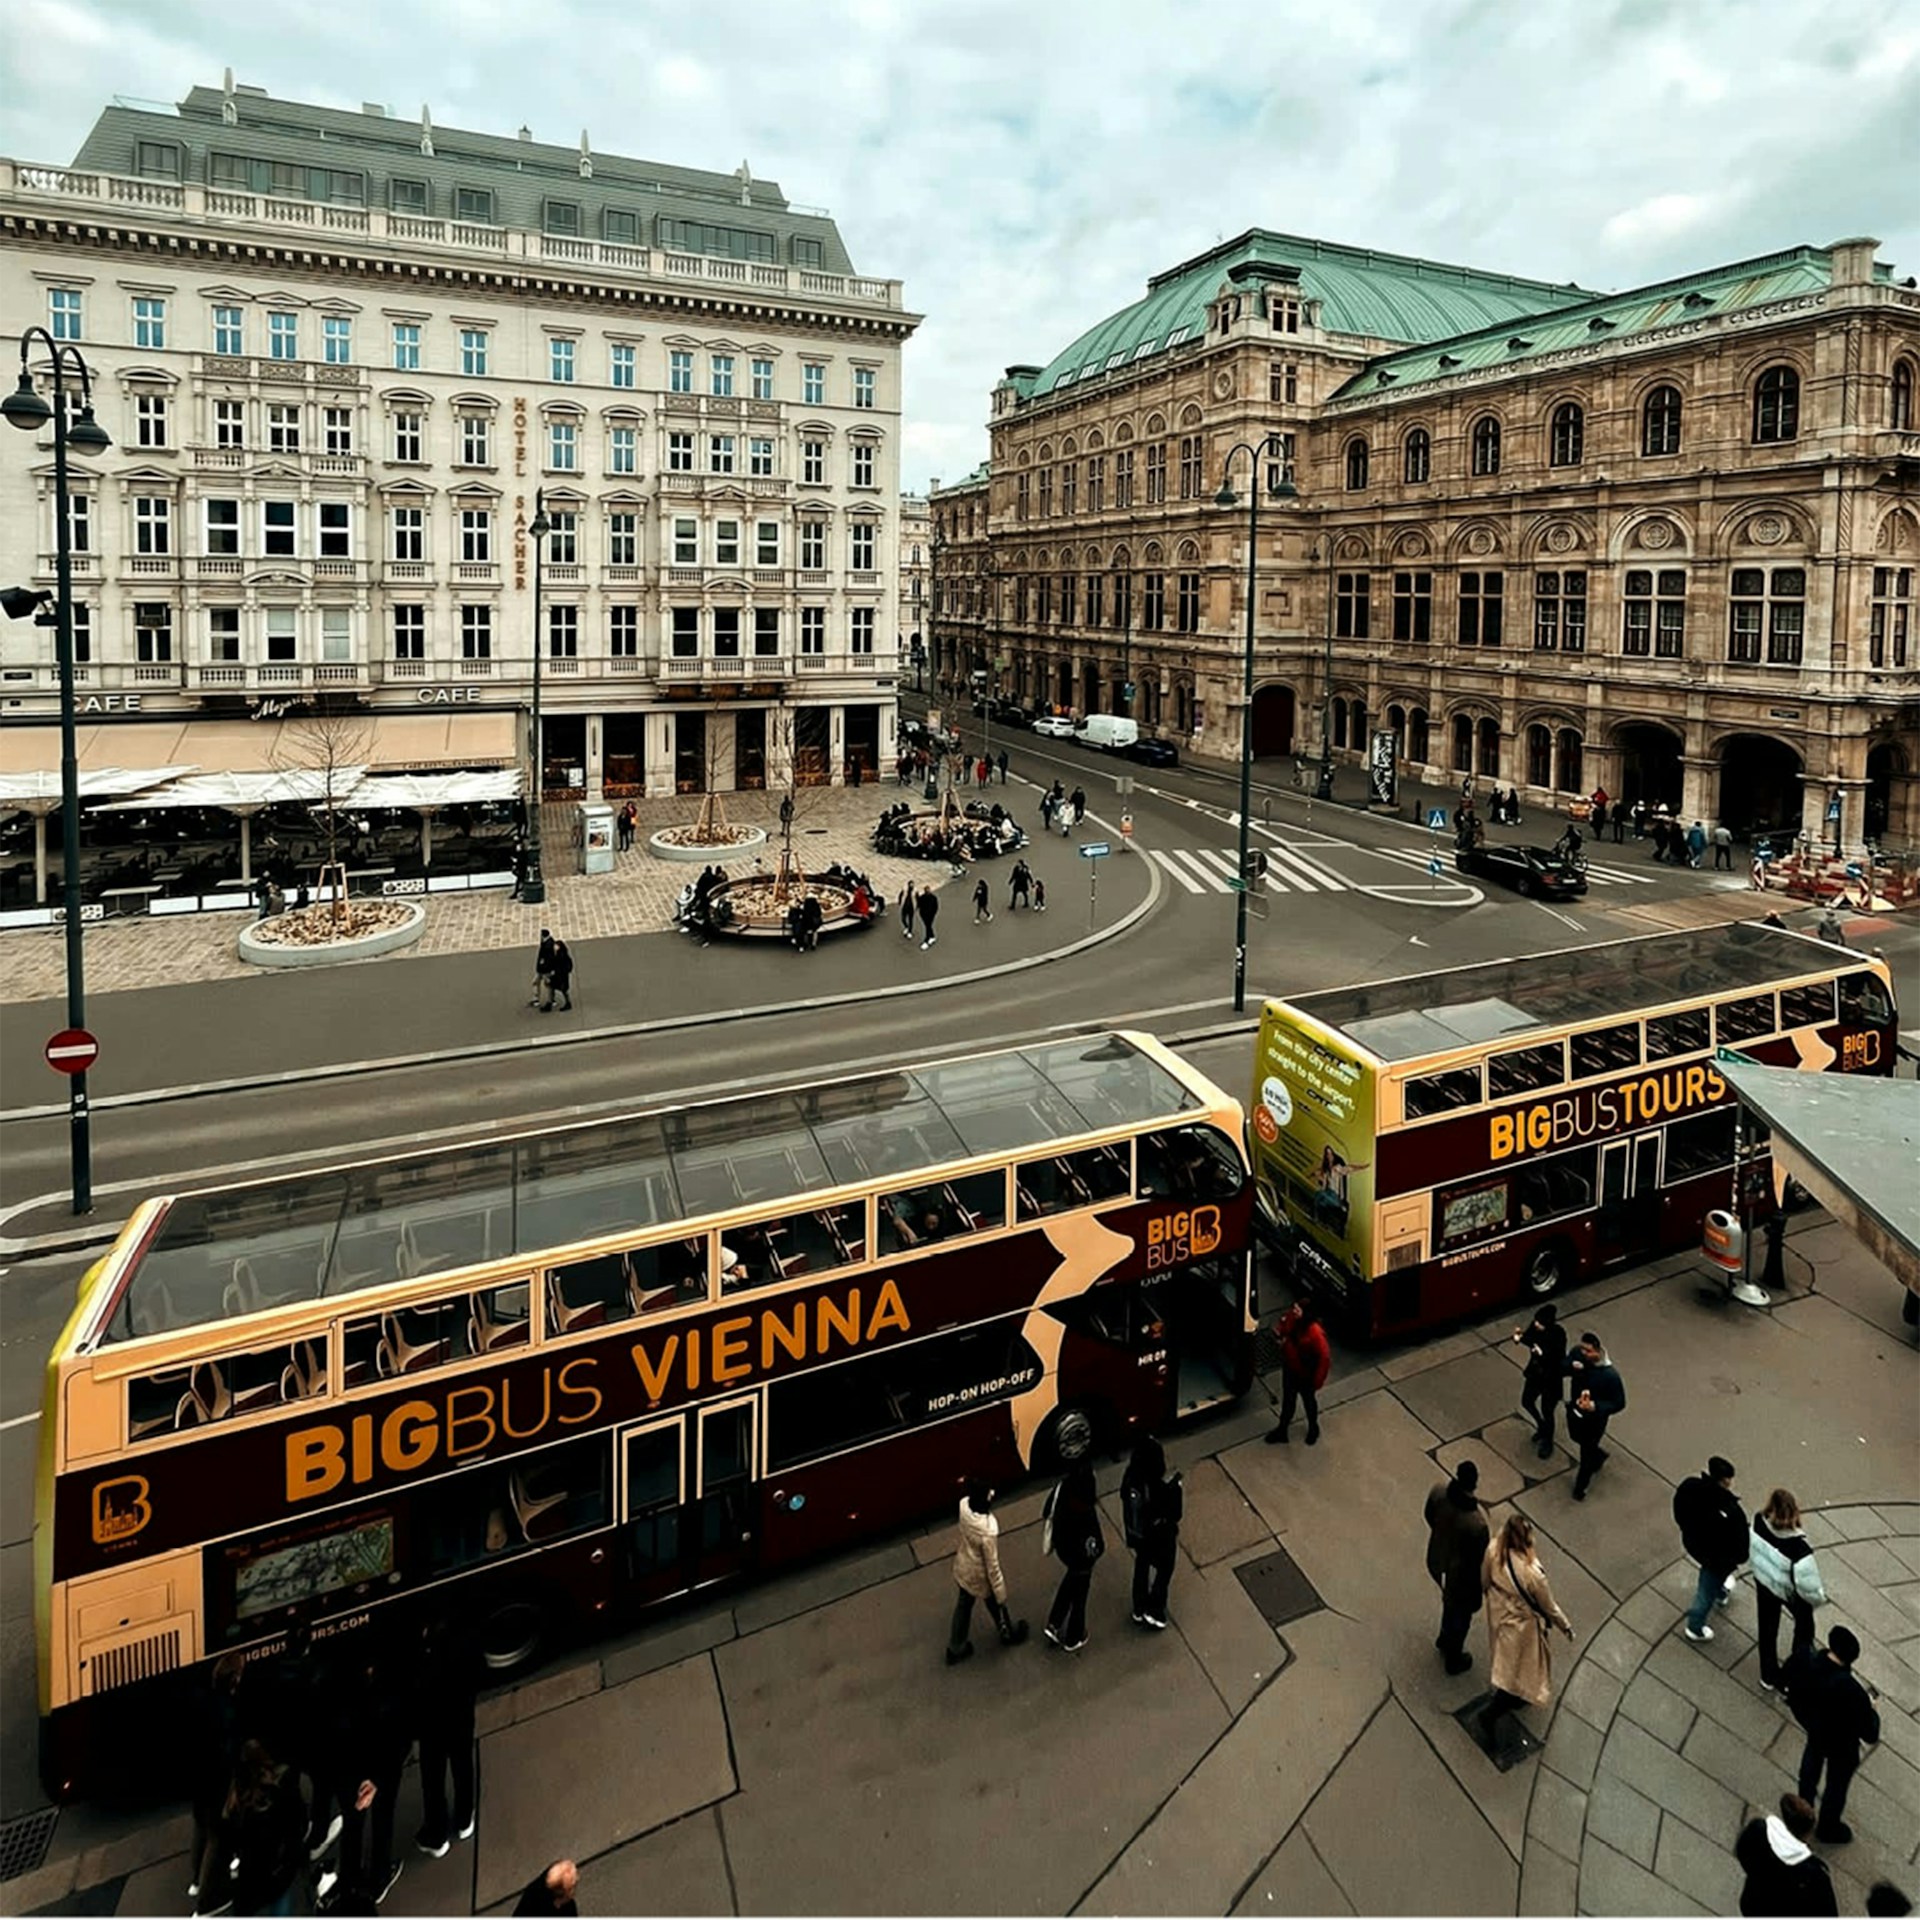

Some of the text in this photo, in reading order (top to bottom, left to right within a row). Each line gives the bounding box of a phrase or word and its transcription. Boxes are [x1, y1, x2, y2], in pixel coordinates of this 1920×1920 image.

[514, 397, 527, 591] HOTEL SACHER
[417, 687, 481, 704] CAFE
[1843, 1032, 1864, 1054] BIG
[1147, 1211, 1190, 1246] BIG
[1147, 1236, 1190, 1269] BUS
[631, 1279, 912, 1402] VIENNA
[928, 1368, 1035, 1411] HOP-ON HOP-OFF
